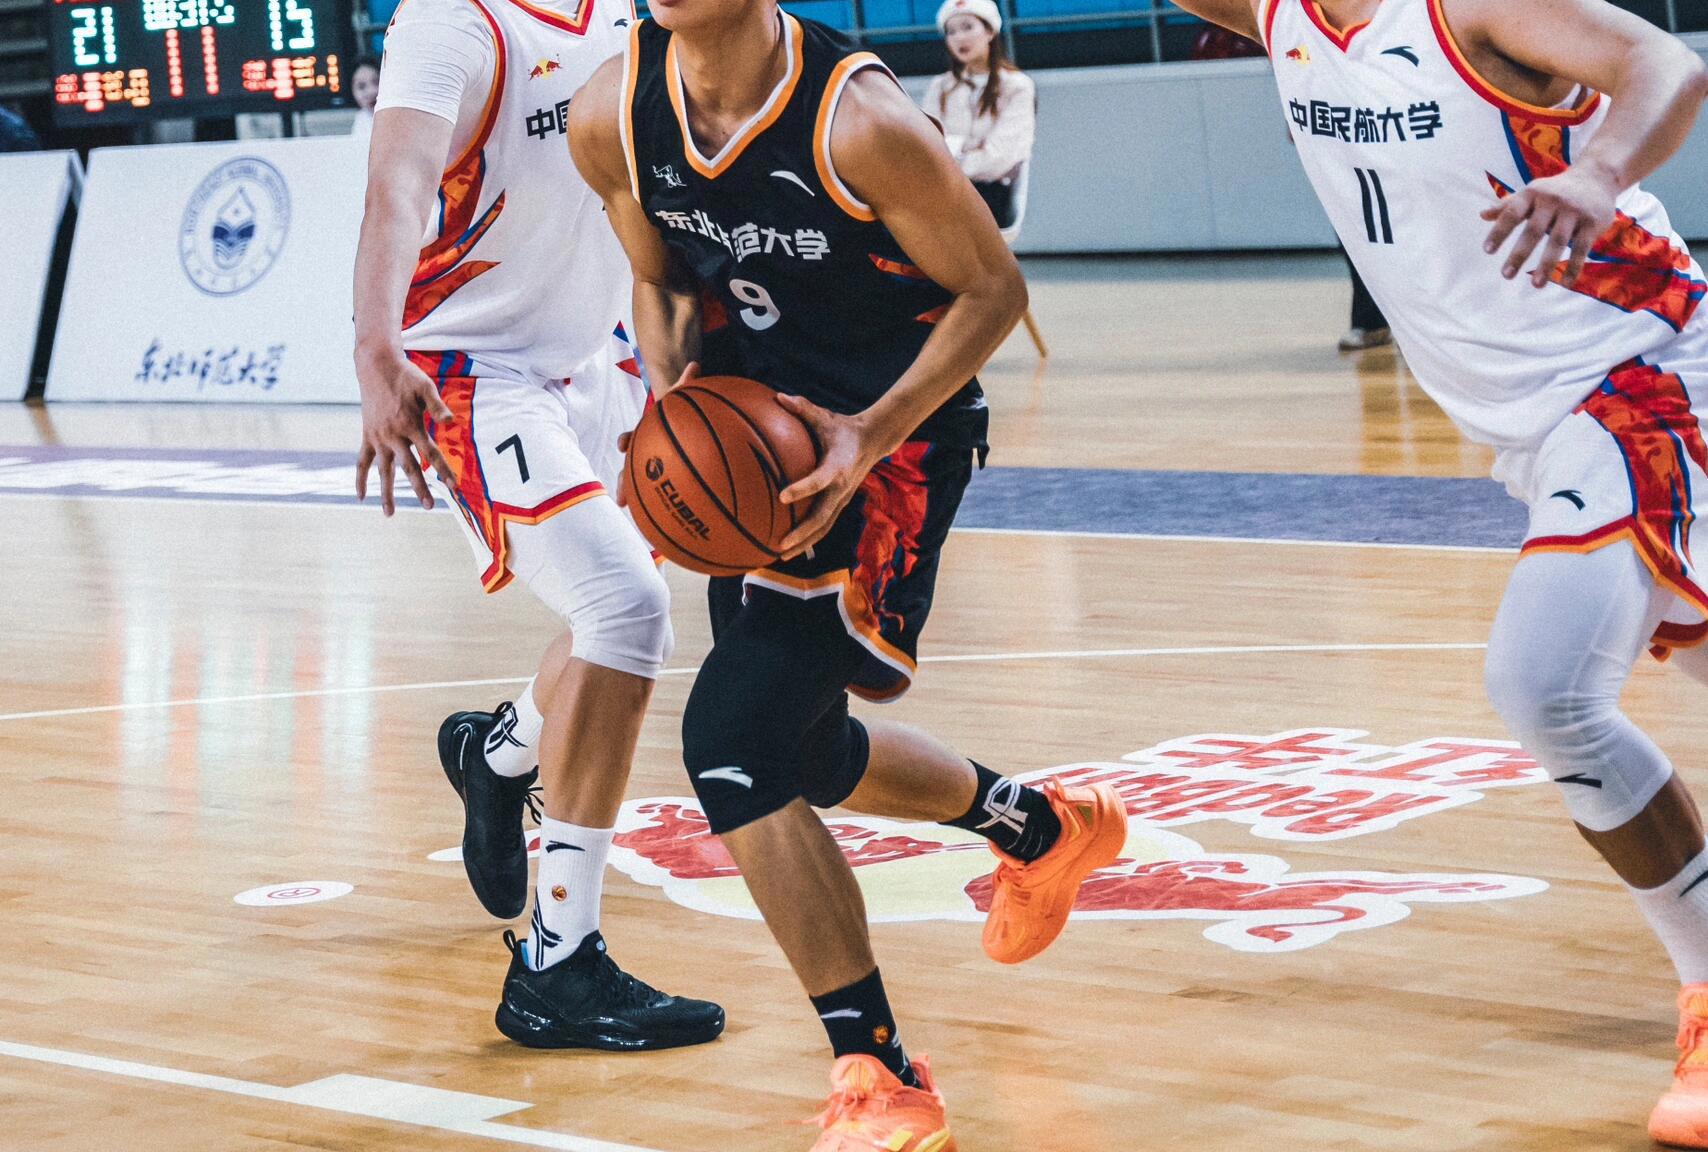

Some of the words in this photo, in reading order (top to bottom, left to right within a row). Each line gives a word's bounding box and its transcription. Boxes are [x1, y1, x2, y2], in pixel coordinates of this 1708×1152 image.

[70, 6, 118, 66] 21
[1289, 97, 1443, 143] 中国民航大学
[1353, 167, 1394, 244] 11
[729, 278, 781, 331] 9
[495, 433, 530, 484] 7
[660, 478, 711, 542] CUBAL
